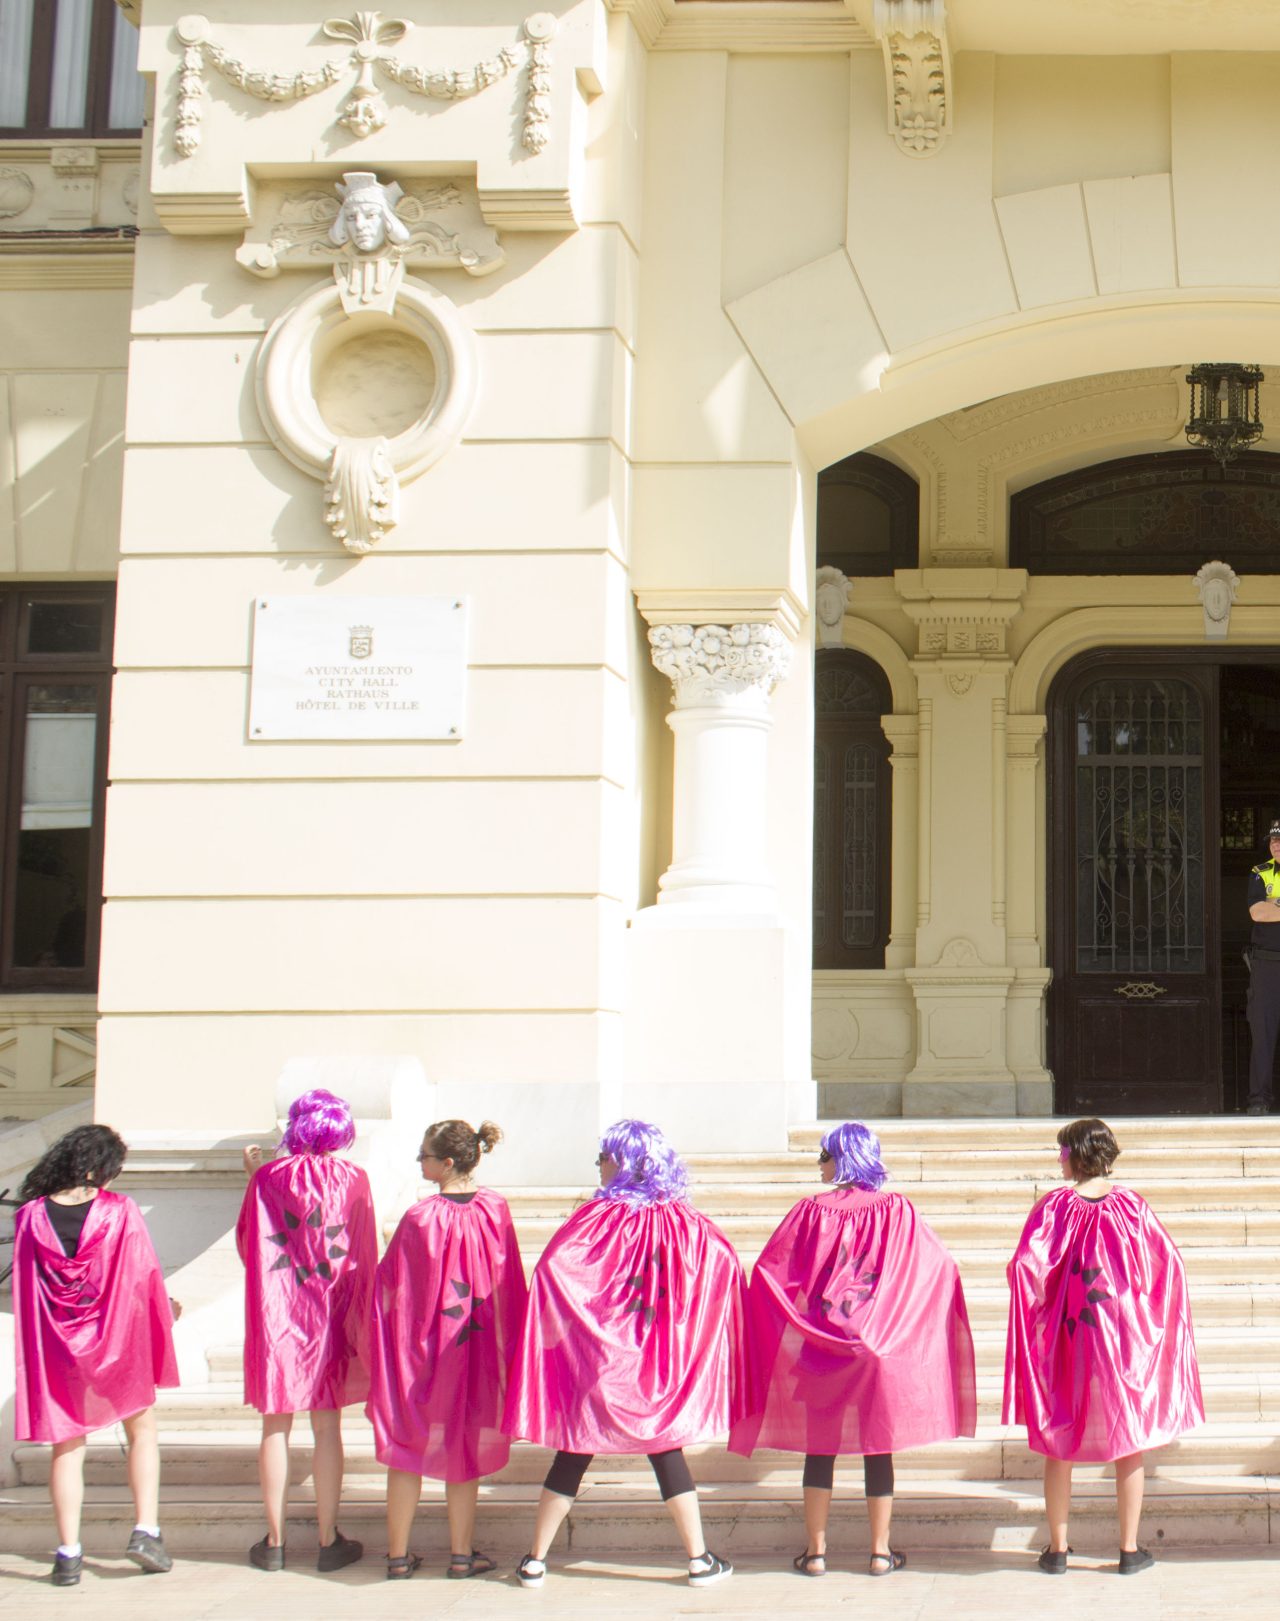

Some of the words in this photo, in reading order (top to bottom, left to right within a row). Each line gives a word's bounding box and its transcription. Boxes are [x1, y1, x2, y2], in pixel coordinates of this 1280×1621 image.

[305, 666, 413, 676] AYUNTAMIENTO
[319, 678, 354, 687] CITY
[362, 678, 398, 687] HALL
[327, 689, 389, 698] RATHAUS
[296, 699, 340, 710] HÔTEL
[348, 701, 366, 710] DE
[374, 701, 419, 710] VILLE
